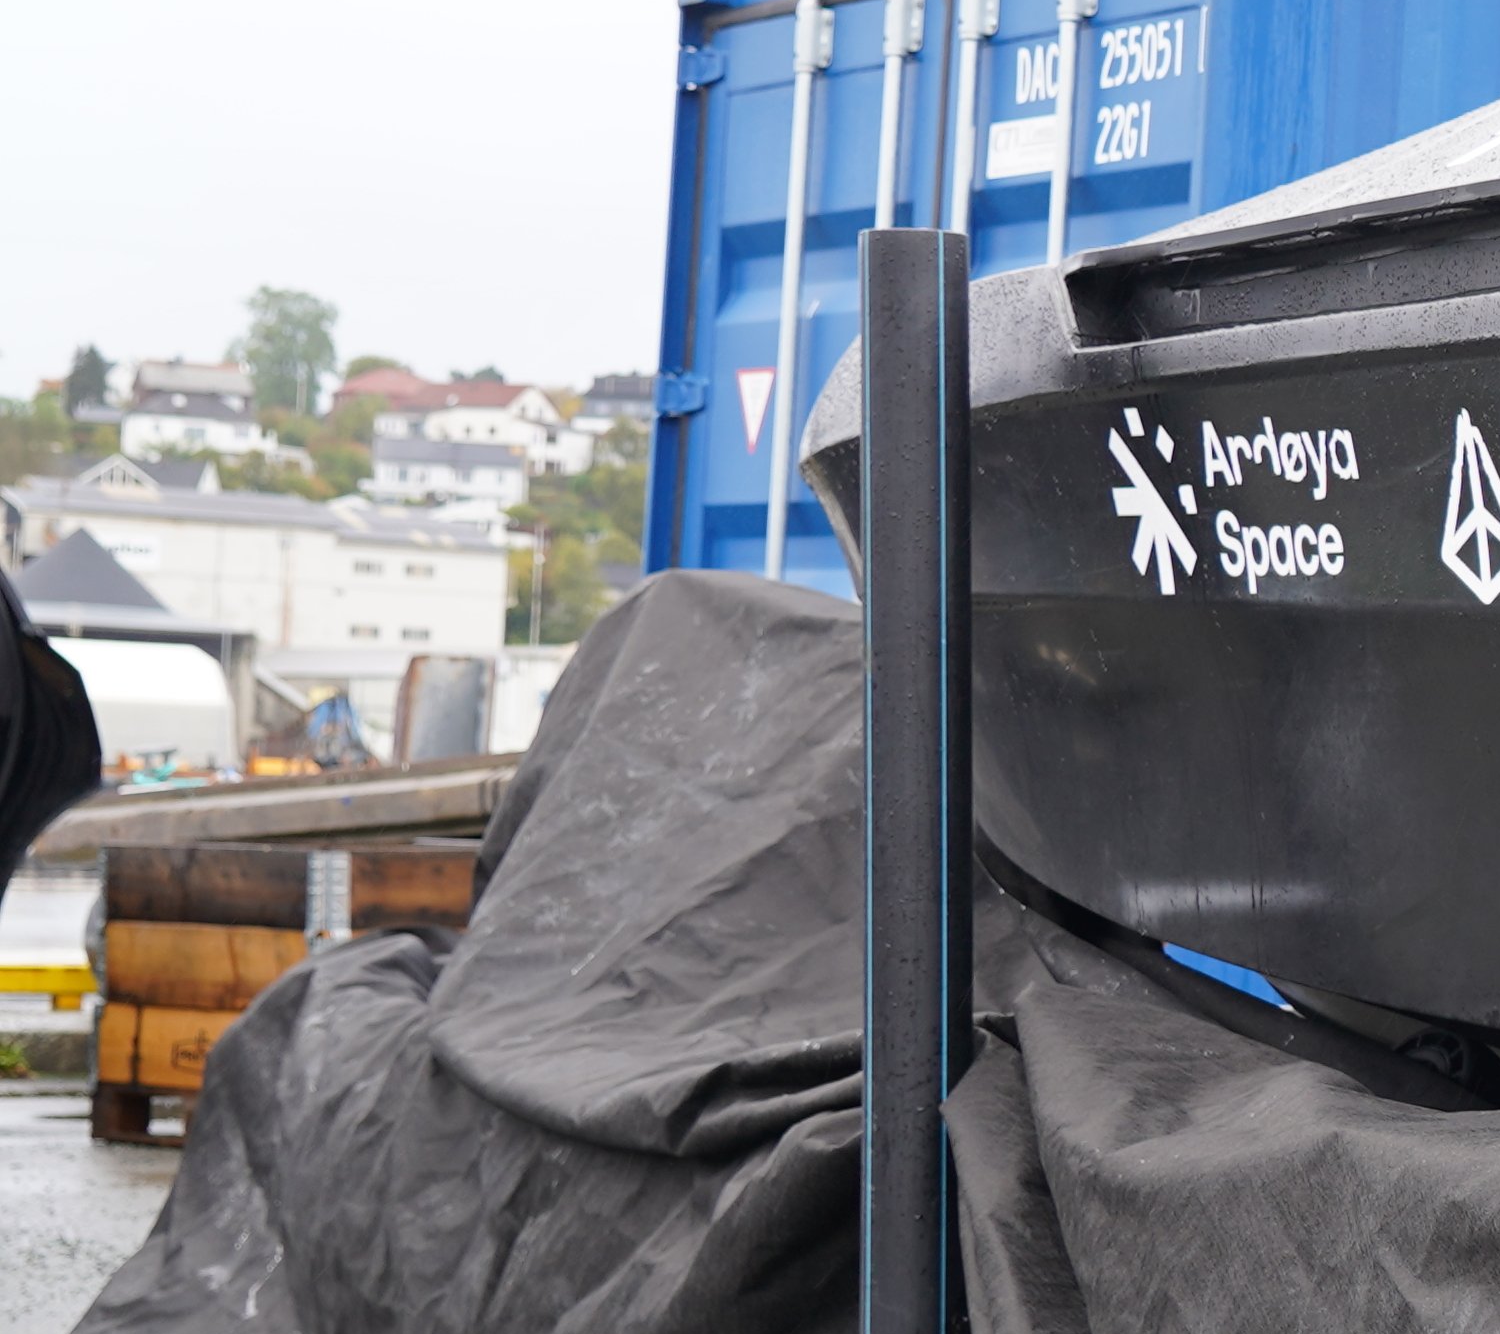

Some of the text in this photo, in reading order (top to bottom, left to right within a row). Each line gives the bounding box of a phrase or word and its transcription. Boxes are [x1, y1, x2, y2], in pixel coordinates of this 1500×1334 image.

[1015, 18, 1184, 105] DAC 255051
[1094, 99, 1151, 165] 22G1
[1216, 509, 1345, 595] Space
